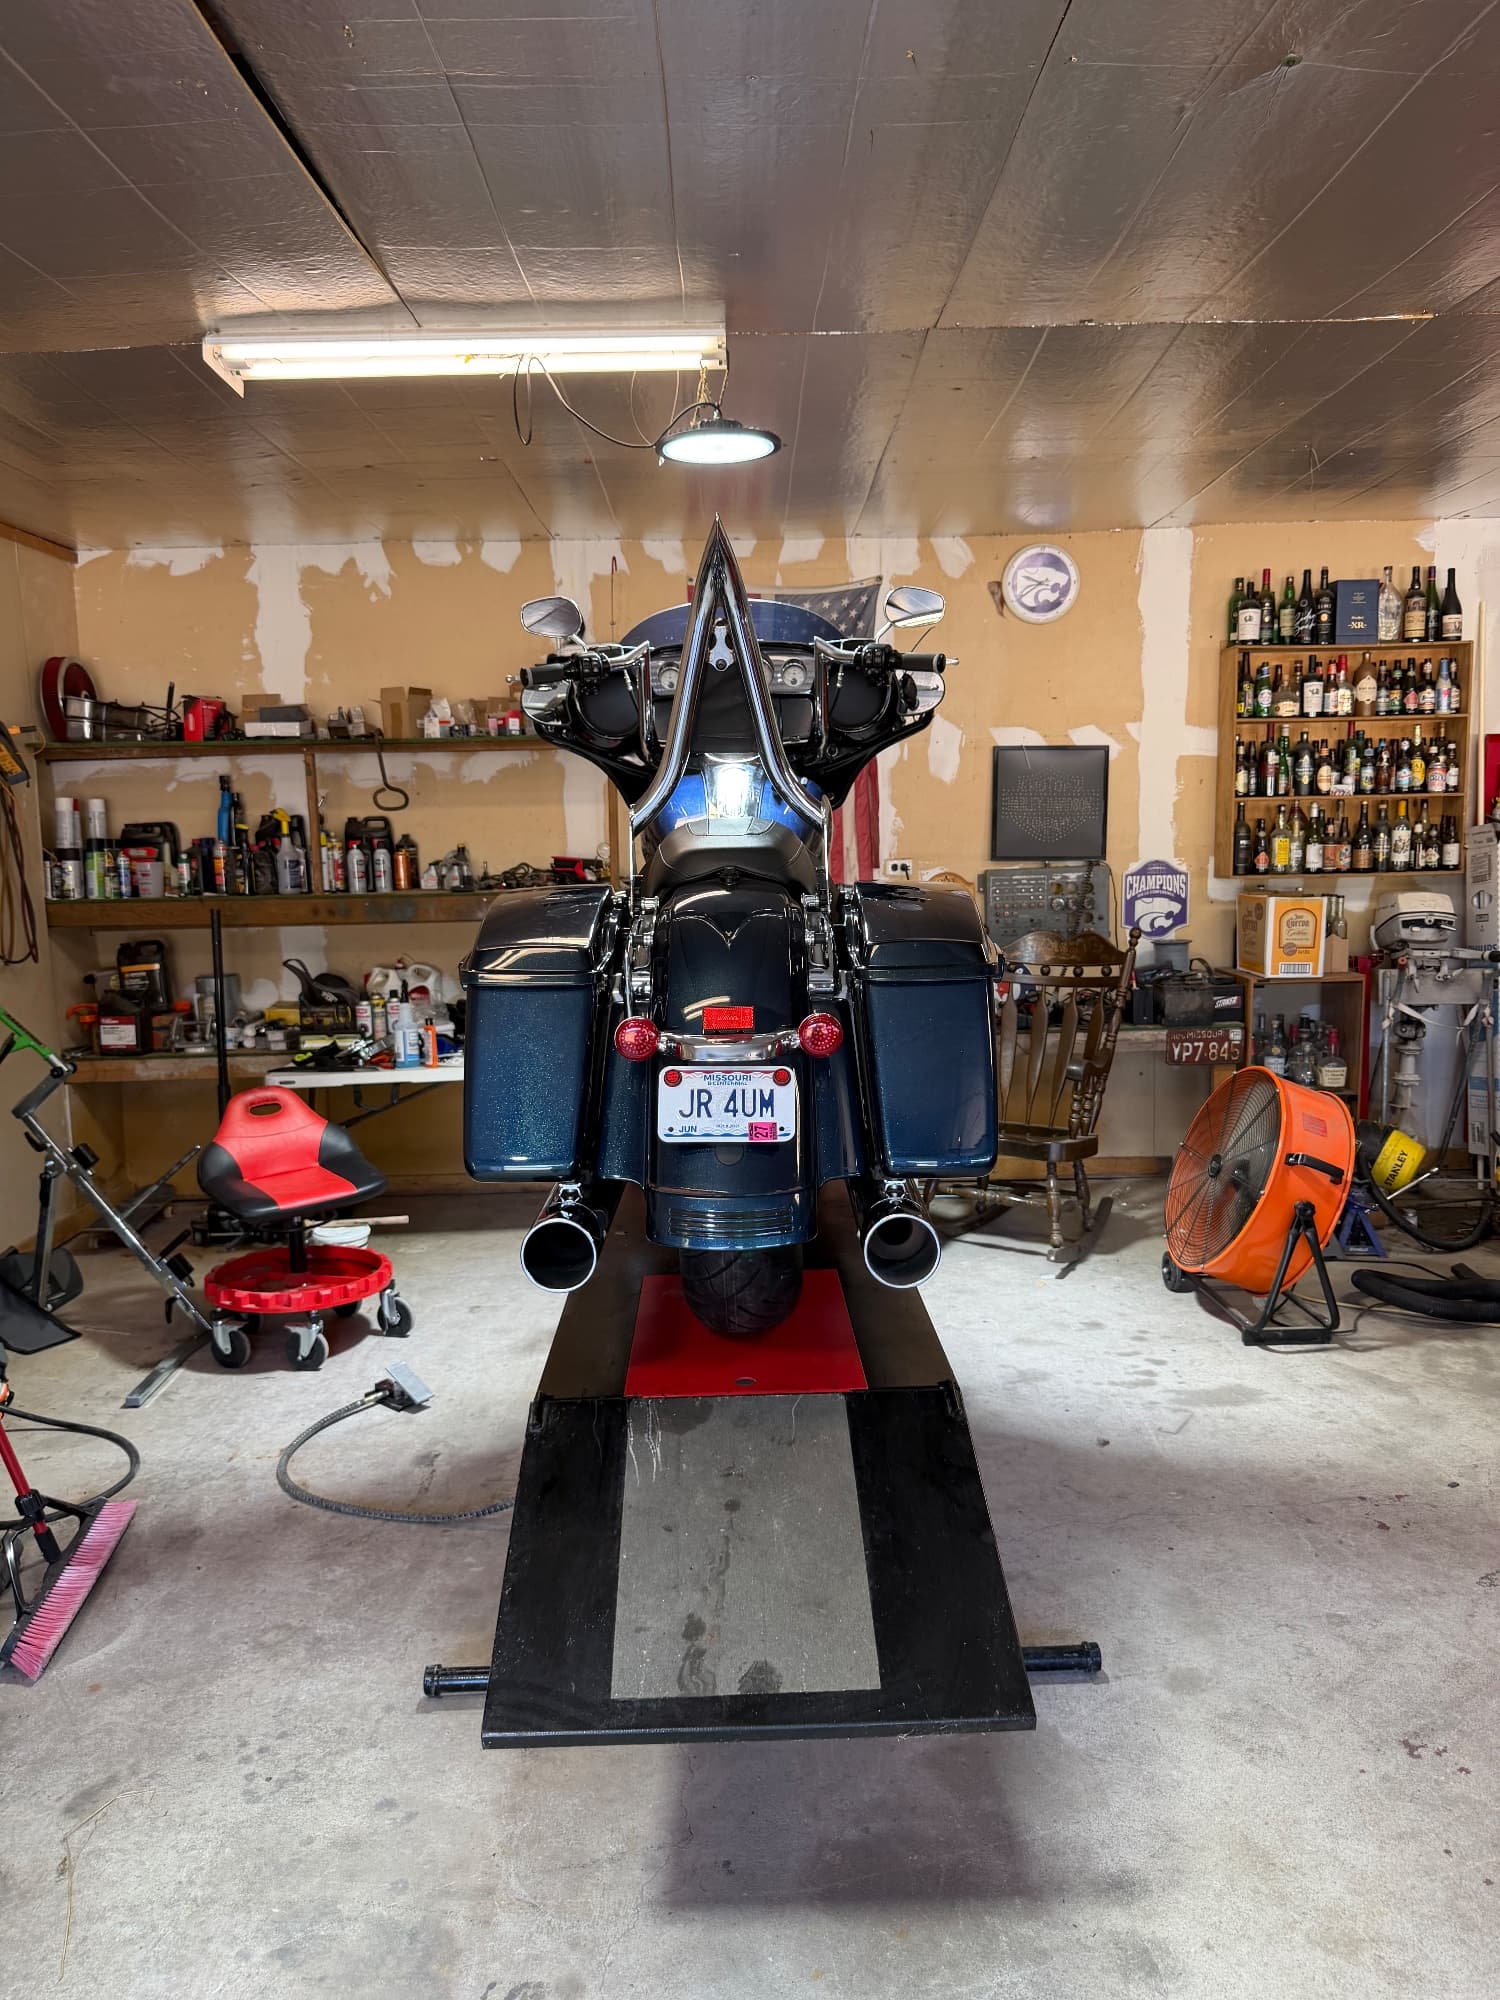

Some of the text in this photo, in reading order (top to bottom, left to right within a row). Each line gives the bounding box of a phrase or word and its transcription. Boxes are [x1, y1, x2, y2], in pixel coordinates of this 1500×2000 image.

[1126, 874, 1186, 900] CHAMPIONS
[679, 1089, 774, 1118] JR 4UM
[754, 1126, 768, 1138] 27
[1384, 1150, 1408, 1186] STANLEY
